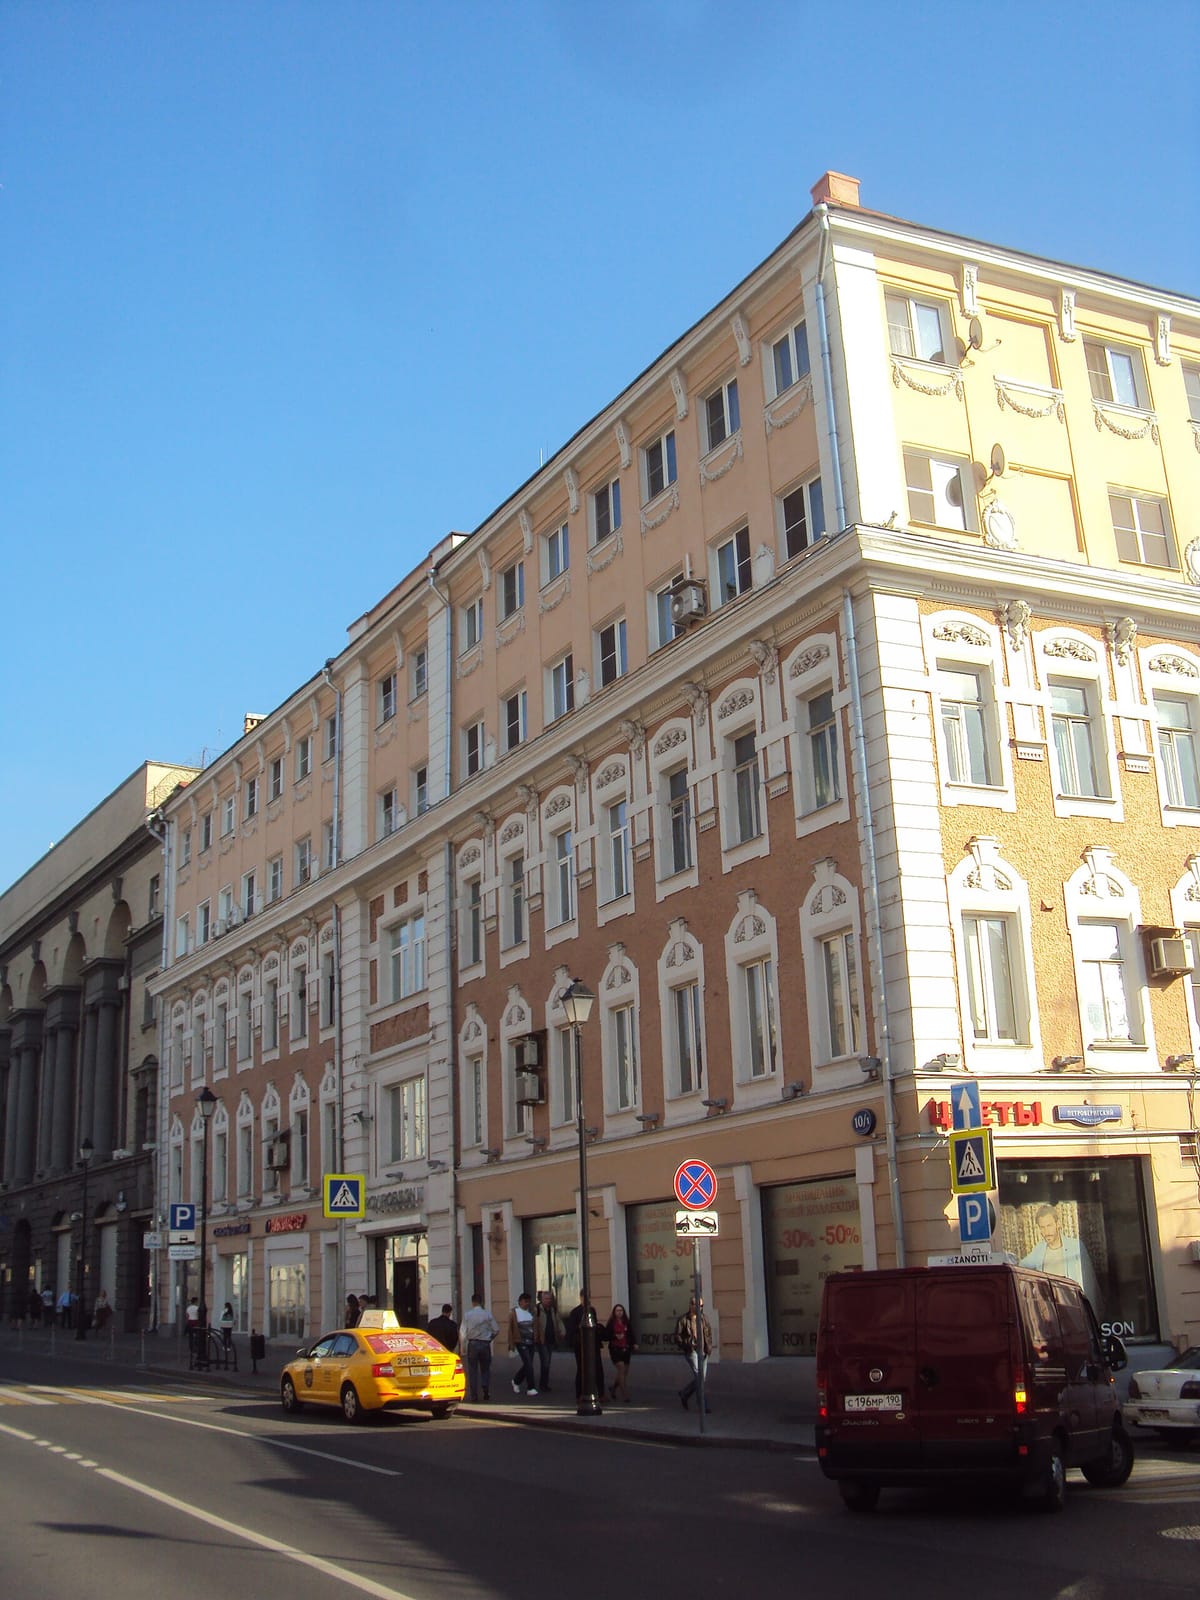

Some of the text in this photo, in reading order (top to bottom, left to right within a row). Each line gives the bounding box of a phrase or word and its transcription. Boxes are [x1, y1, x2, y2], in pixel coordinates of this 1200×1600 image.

[929, 1098, 1043, 1131] ЦЕТЫ
[779, 1223, 861, 1249] -30% -50%
[954, 1254, 988, 1264] ZANOTTI
